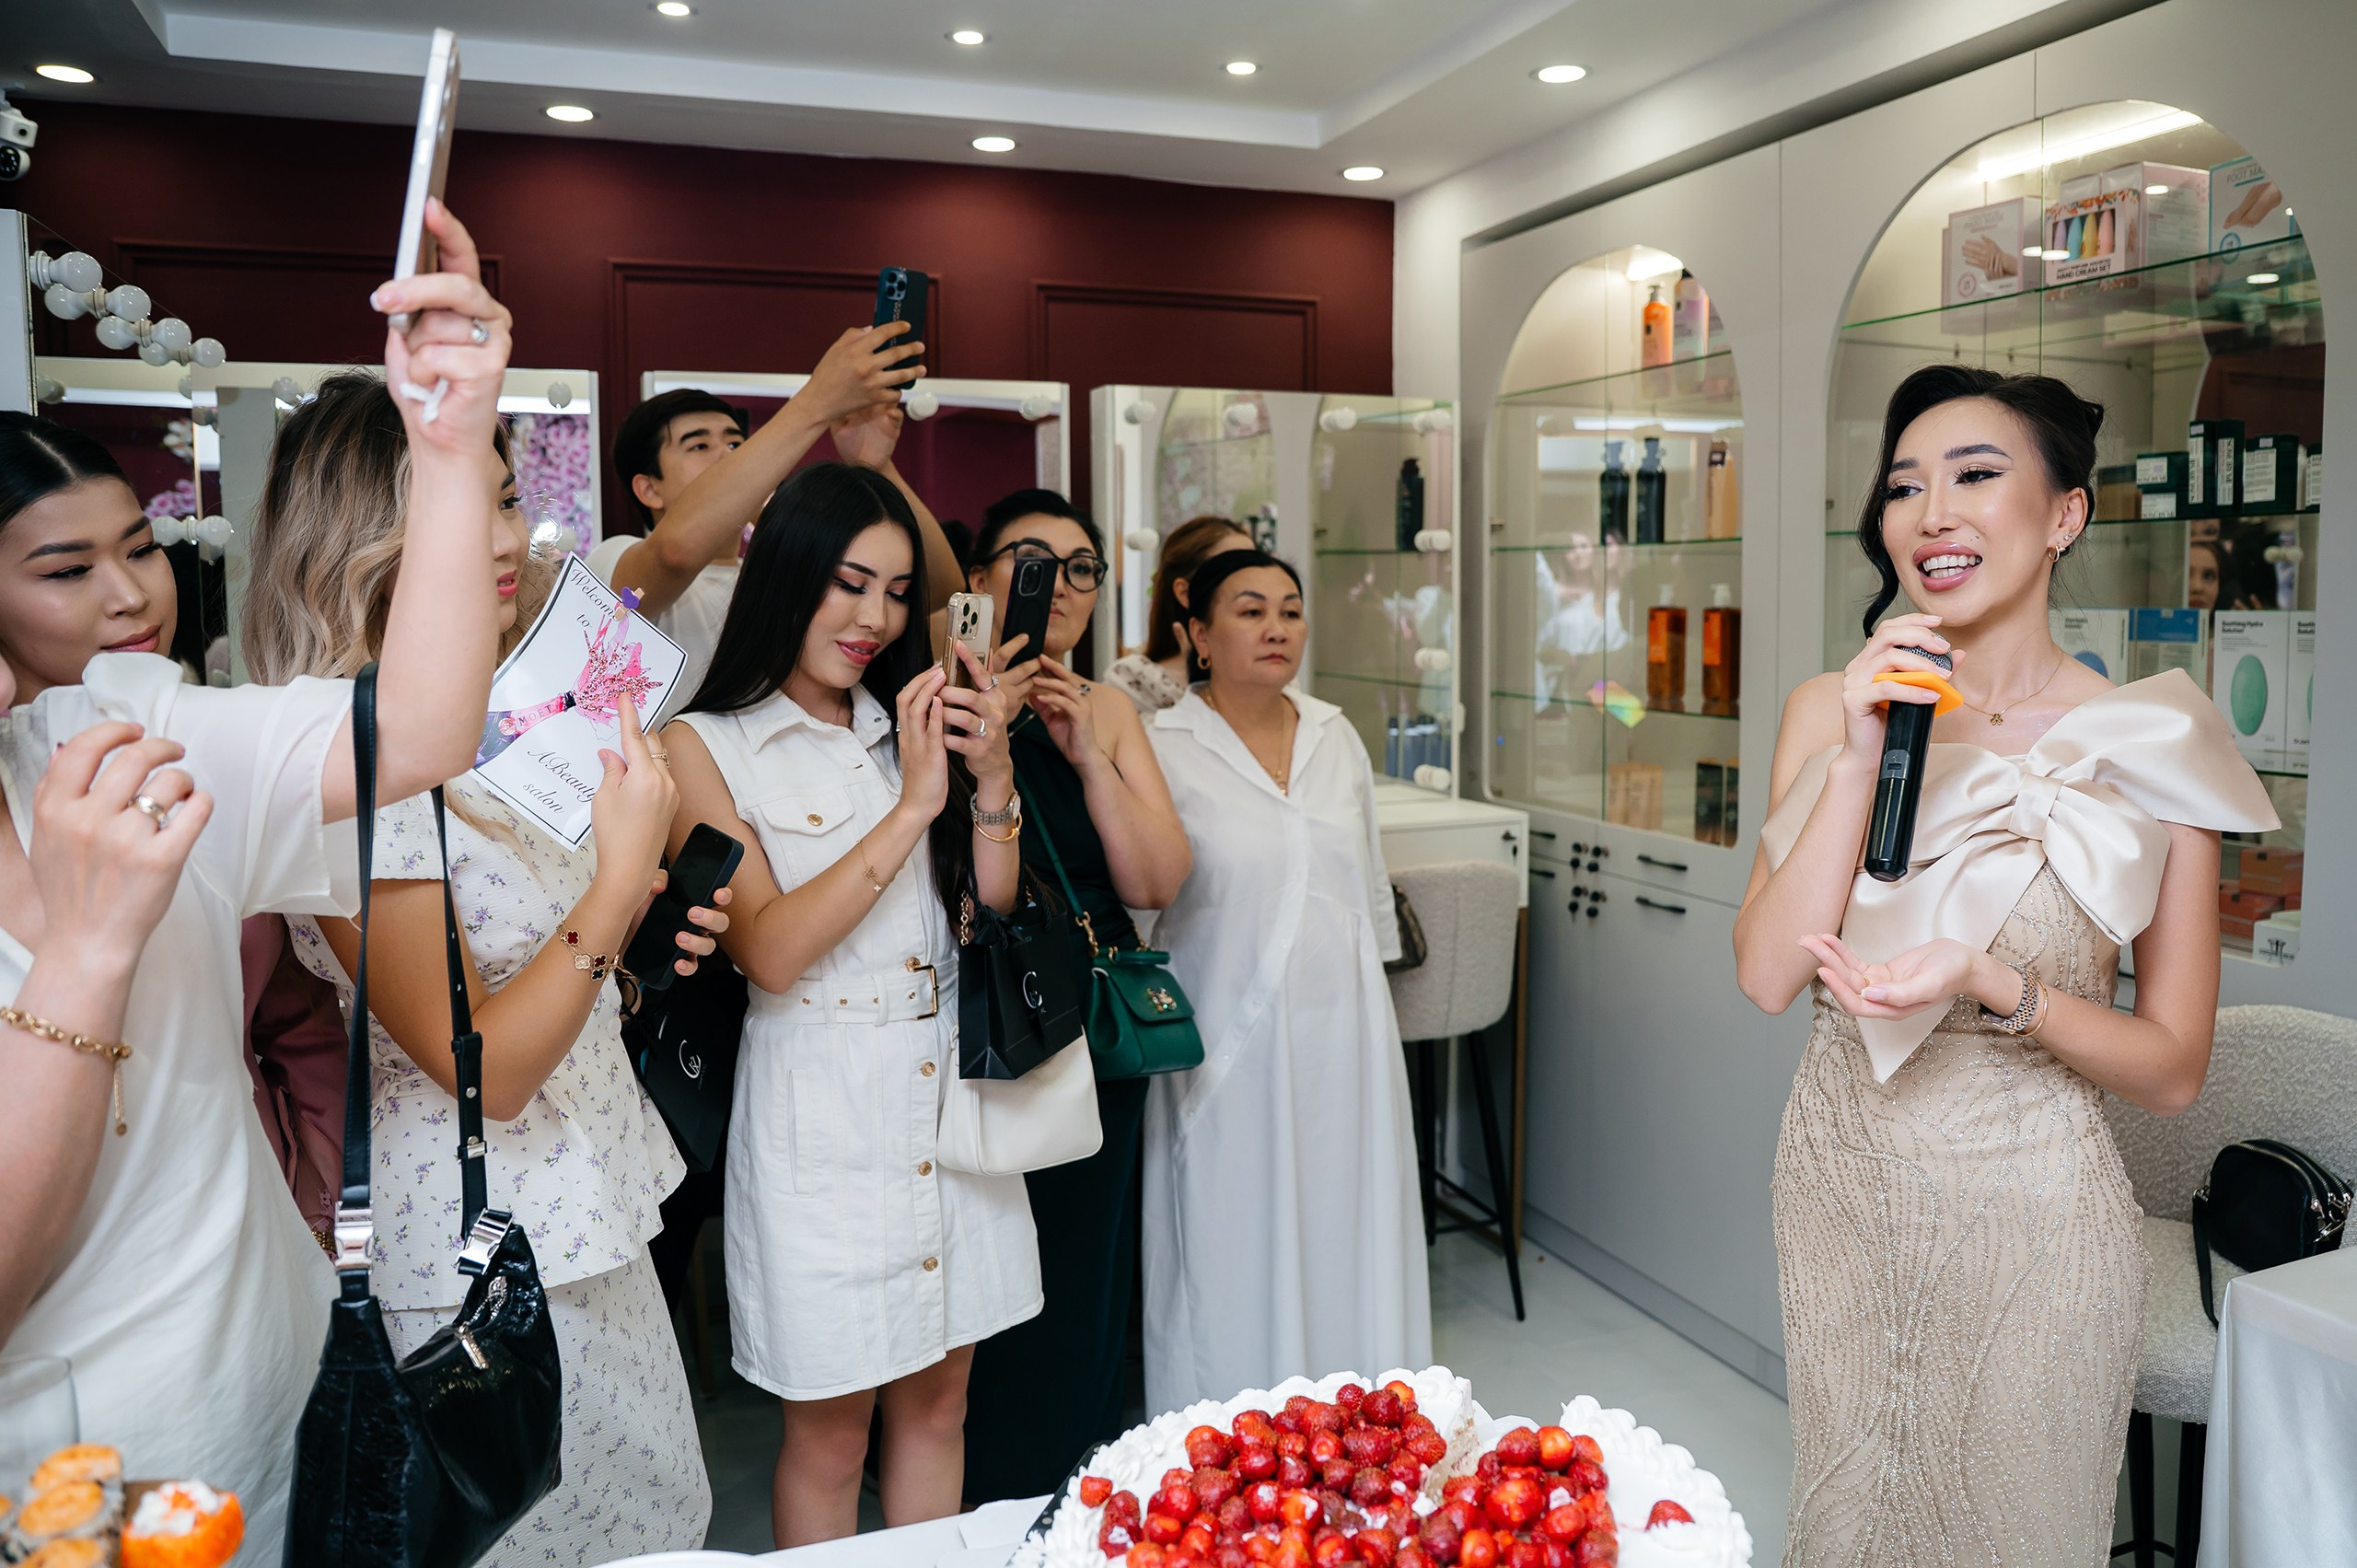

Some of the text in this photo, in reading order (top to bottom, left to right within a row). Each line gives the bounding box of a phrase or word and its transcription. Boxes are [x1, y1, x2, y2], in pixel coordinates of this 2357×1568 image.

[2075, 266, 2098, 277] CREAM
[2099, 262, 2111, 272] SET
[571, 568, 615, 620] Welcom
[576, 613, 592, 627] to
[523, 783, 565, 814] salon
